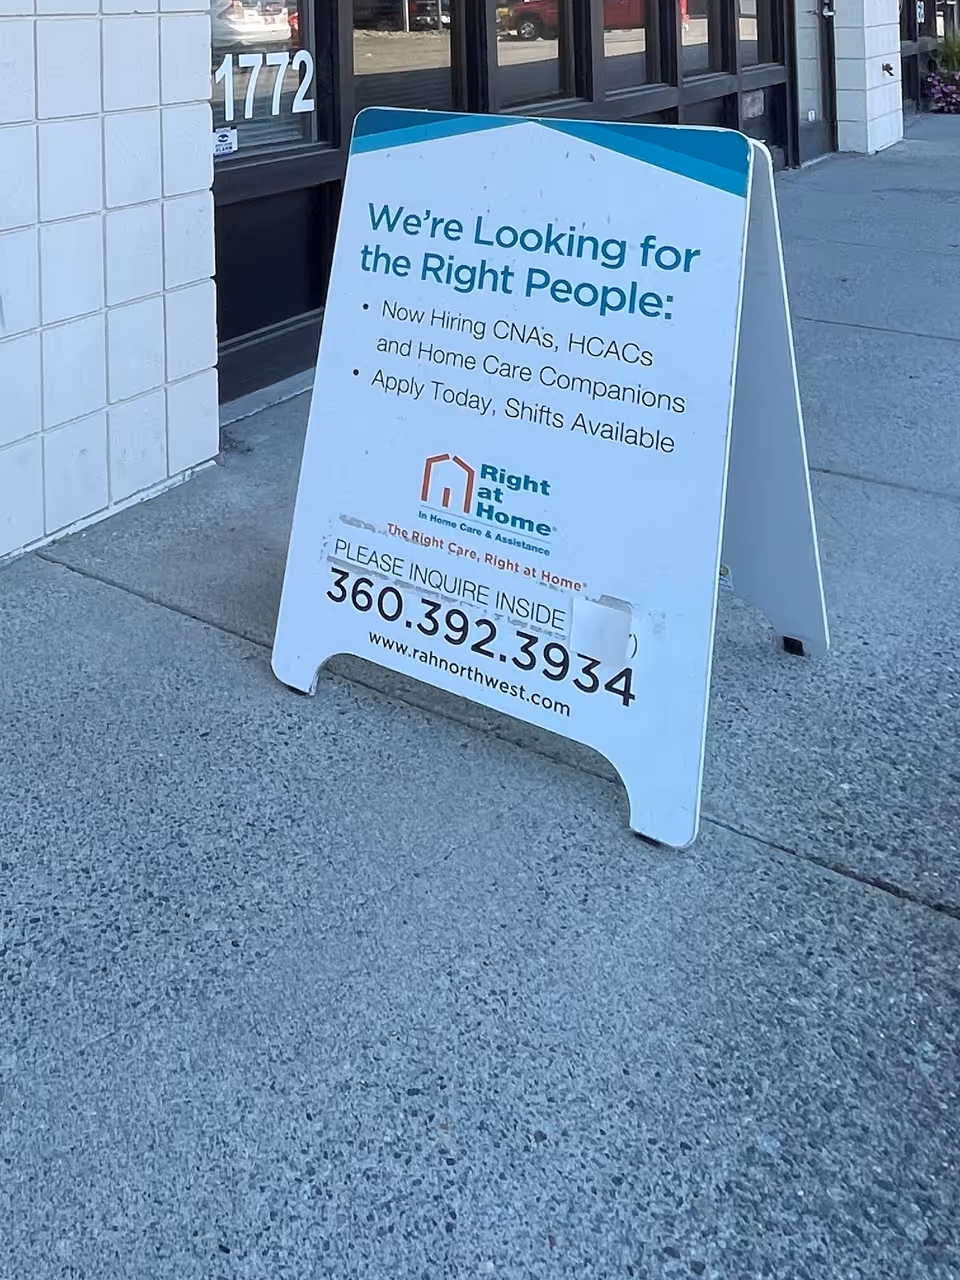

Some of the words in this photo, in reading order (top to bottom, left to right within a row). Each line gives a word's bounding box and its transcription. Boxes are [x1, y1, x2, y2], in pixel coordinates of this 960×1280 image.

[215, 50, 315, 121] 1772
[368, 203, 463, 241] We're
[475, 216, 626, 270] Looking
[641, 235, 701, 273] for
[361, 246, 411, 278] the
[422, 253, 515, 294] Right
[526, 269, 673, 320] People:
[382, 301, 425, 324] Now
[430, 310, 486, 339] Hiring
[493, 319, 559, 353] CNAs,
[568, 336, 653, 368] HCACs
[376, 335, 411, 359] and
[418, 342, 476, 371] Home
[483, 354, 532, 382] Care
[539, 365, 686, 413] Companions
[371, 369, 425, 399] Apply
[432, 381, 496, 416] Today,
[505, 397, 565, 428] Shifts
[571, 412, 675, 453] Available
[478, 486, 503, 503] at
[480, 464, 551, 496] Right
[387, 522, 409, 539] The
[412, 529, 444, 551] Right
[448, 541, 480, 562] Care,
[484, 553, 520, 574] Right
[524, 566, 537, 578] at
[418, 511, 427, 520] In
[430, 513, 457, 529] Home
[460, 522, 482, 536] Care
[485, 529, 492, 538] &
[495, 532, 550, 556] Assistance
[476, 504, 552, 537] Home
[334, 538, 404, 577] PLEASE
[409, 564, 489, 605] INQUIRE
[495, 591, 566, 630] INSIDE
[326, 567, 636, 707] 360.392.3934
[369, 631, 571, 717] www.rahnorthwest.com
